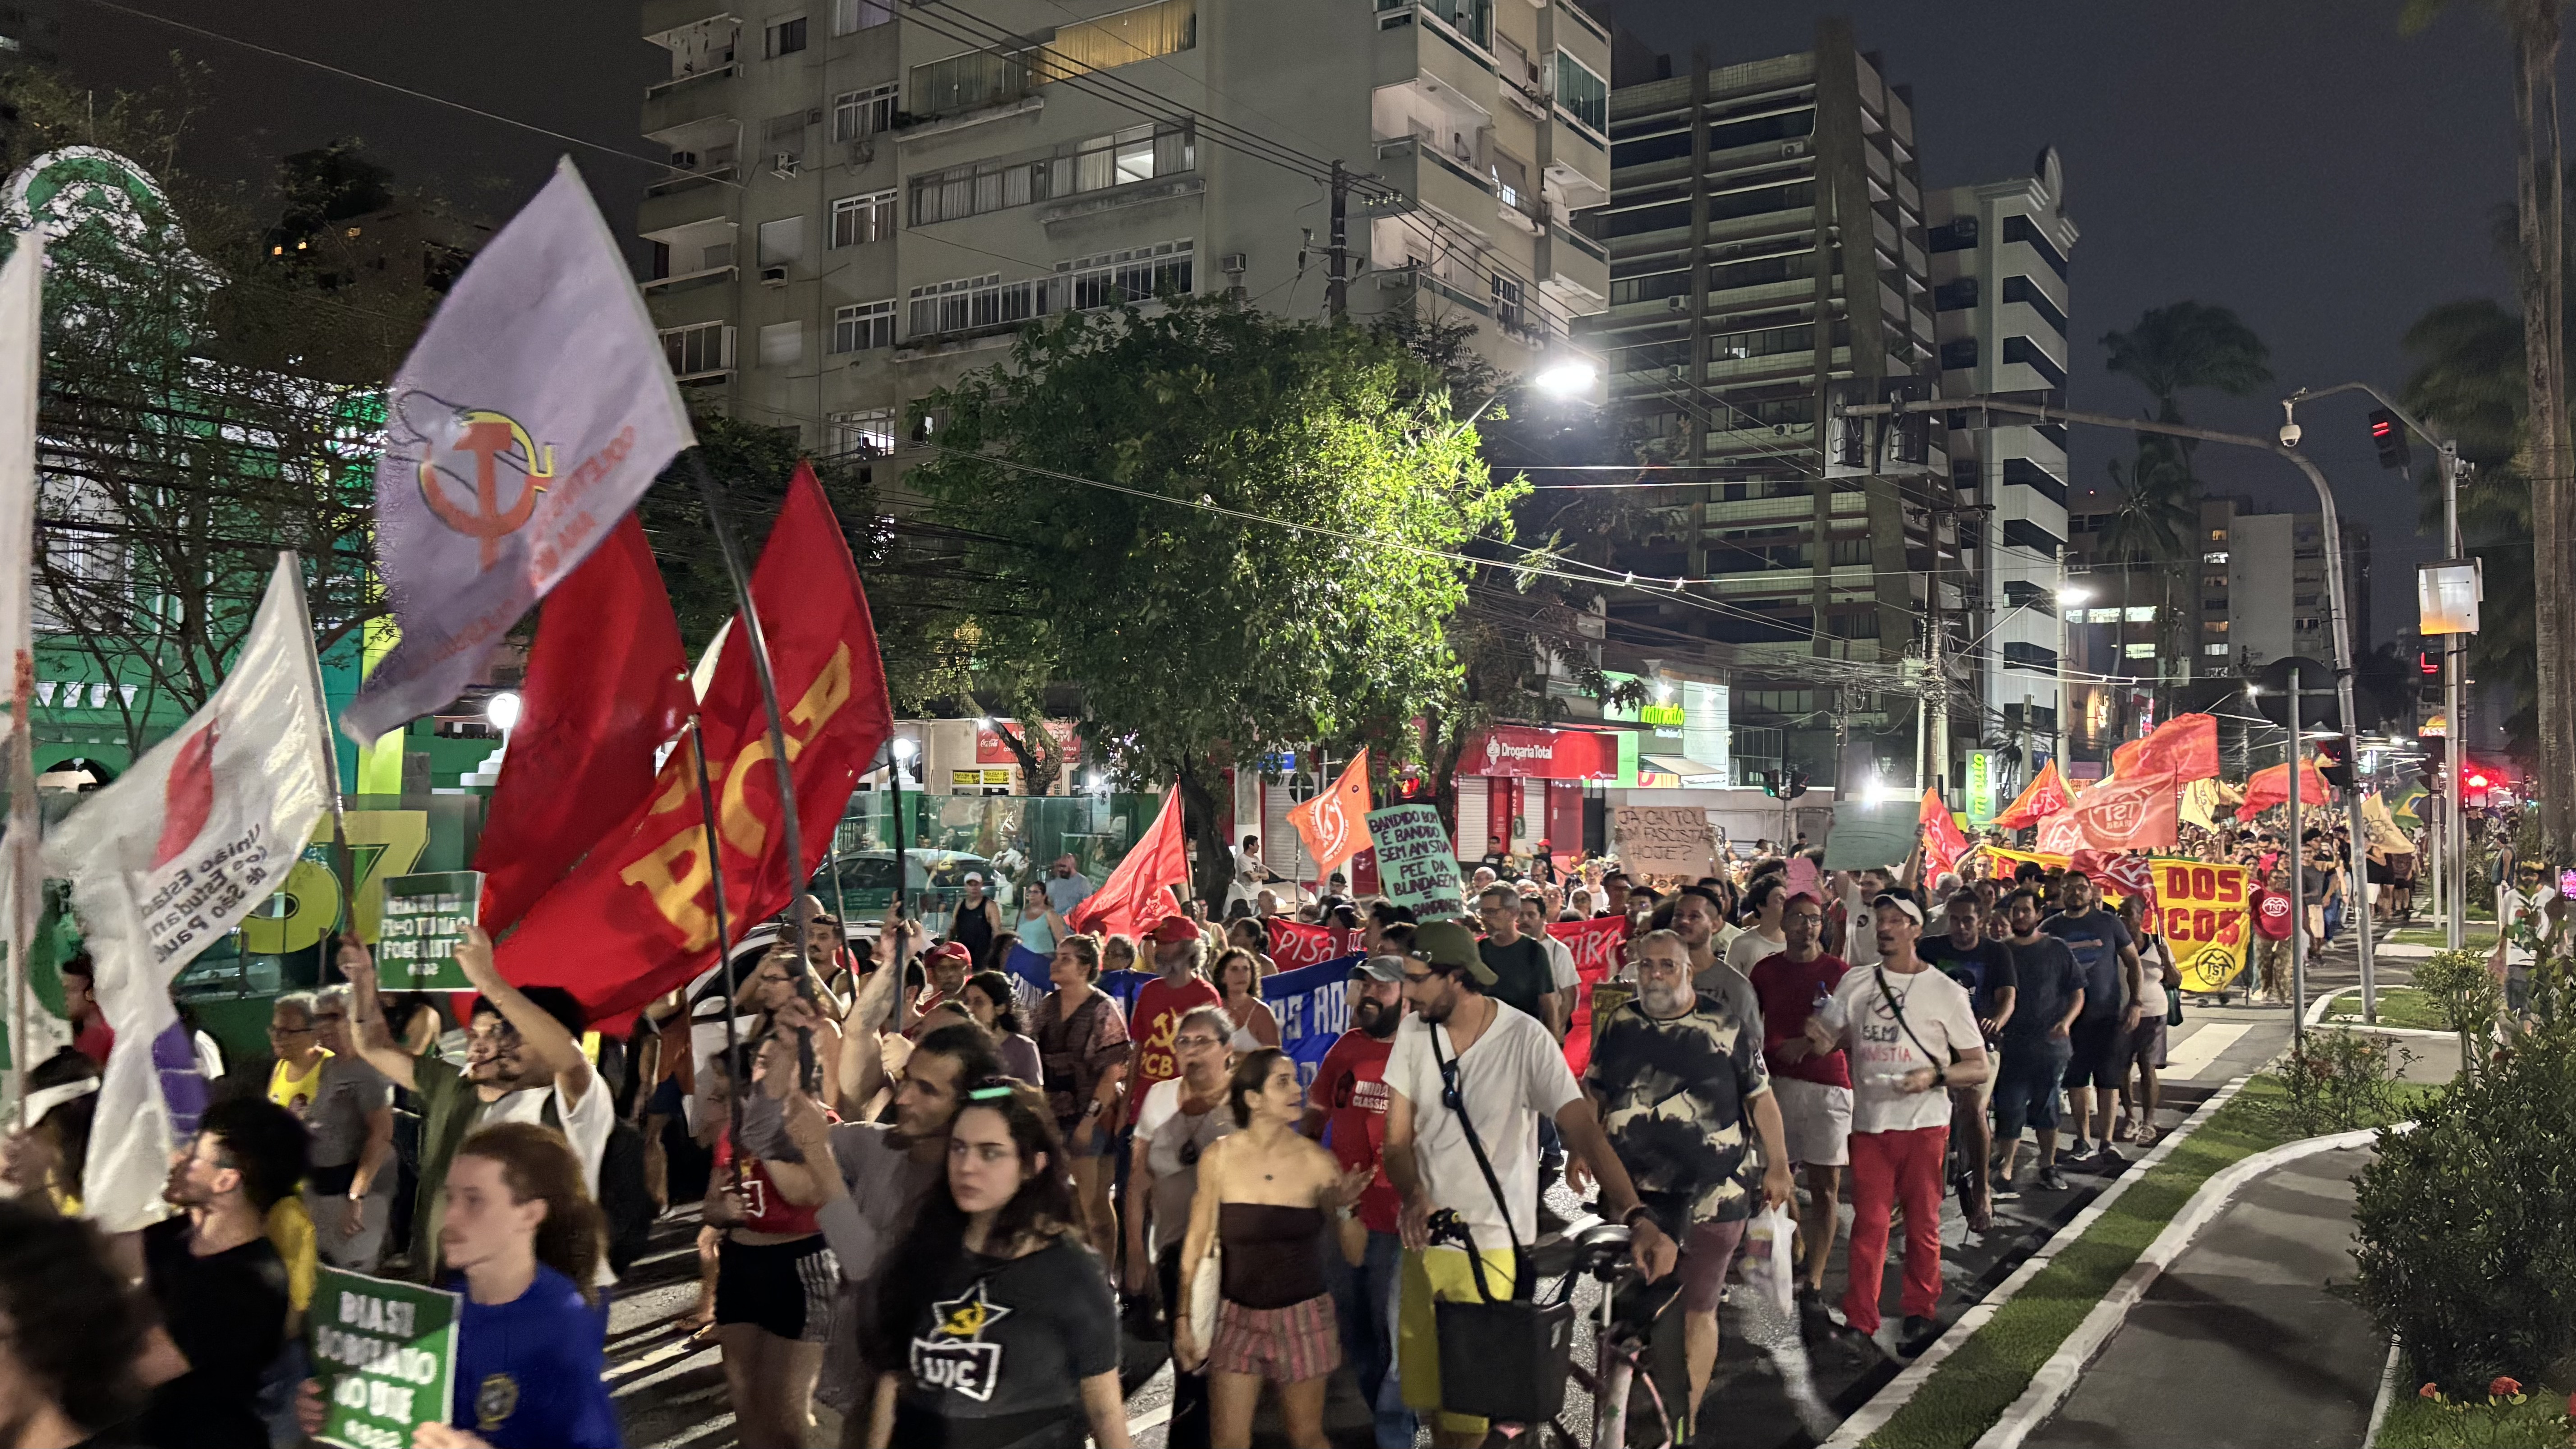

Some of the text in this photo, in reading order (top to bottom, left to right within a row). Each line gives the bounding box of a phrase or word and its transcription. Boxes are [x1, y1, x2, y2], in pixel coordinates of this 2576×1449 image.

[2423, 727, 2446, 736] ASS
[1502, 742, 1552, 760] Drogaria Total
[1368, 810, 1420, 833] BANDIDO
[1394, 826, 1440, 842] BANDIDO
[1378, 840, 1451, 863] SEM ANISTIA
[1431, 860, 1449, 873] DA
[2166, 866, 2241, 902] DOS
[1863, 1025, 1899, 1042] SEM
